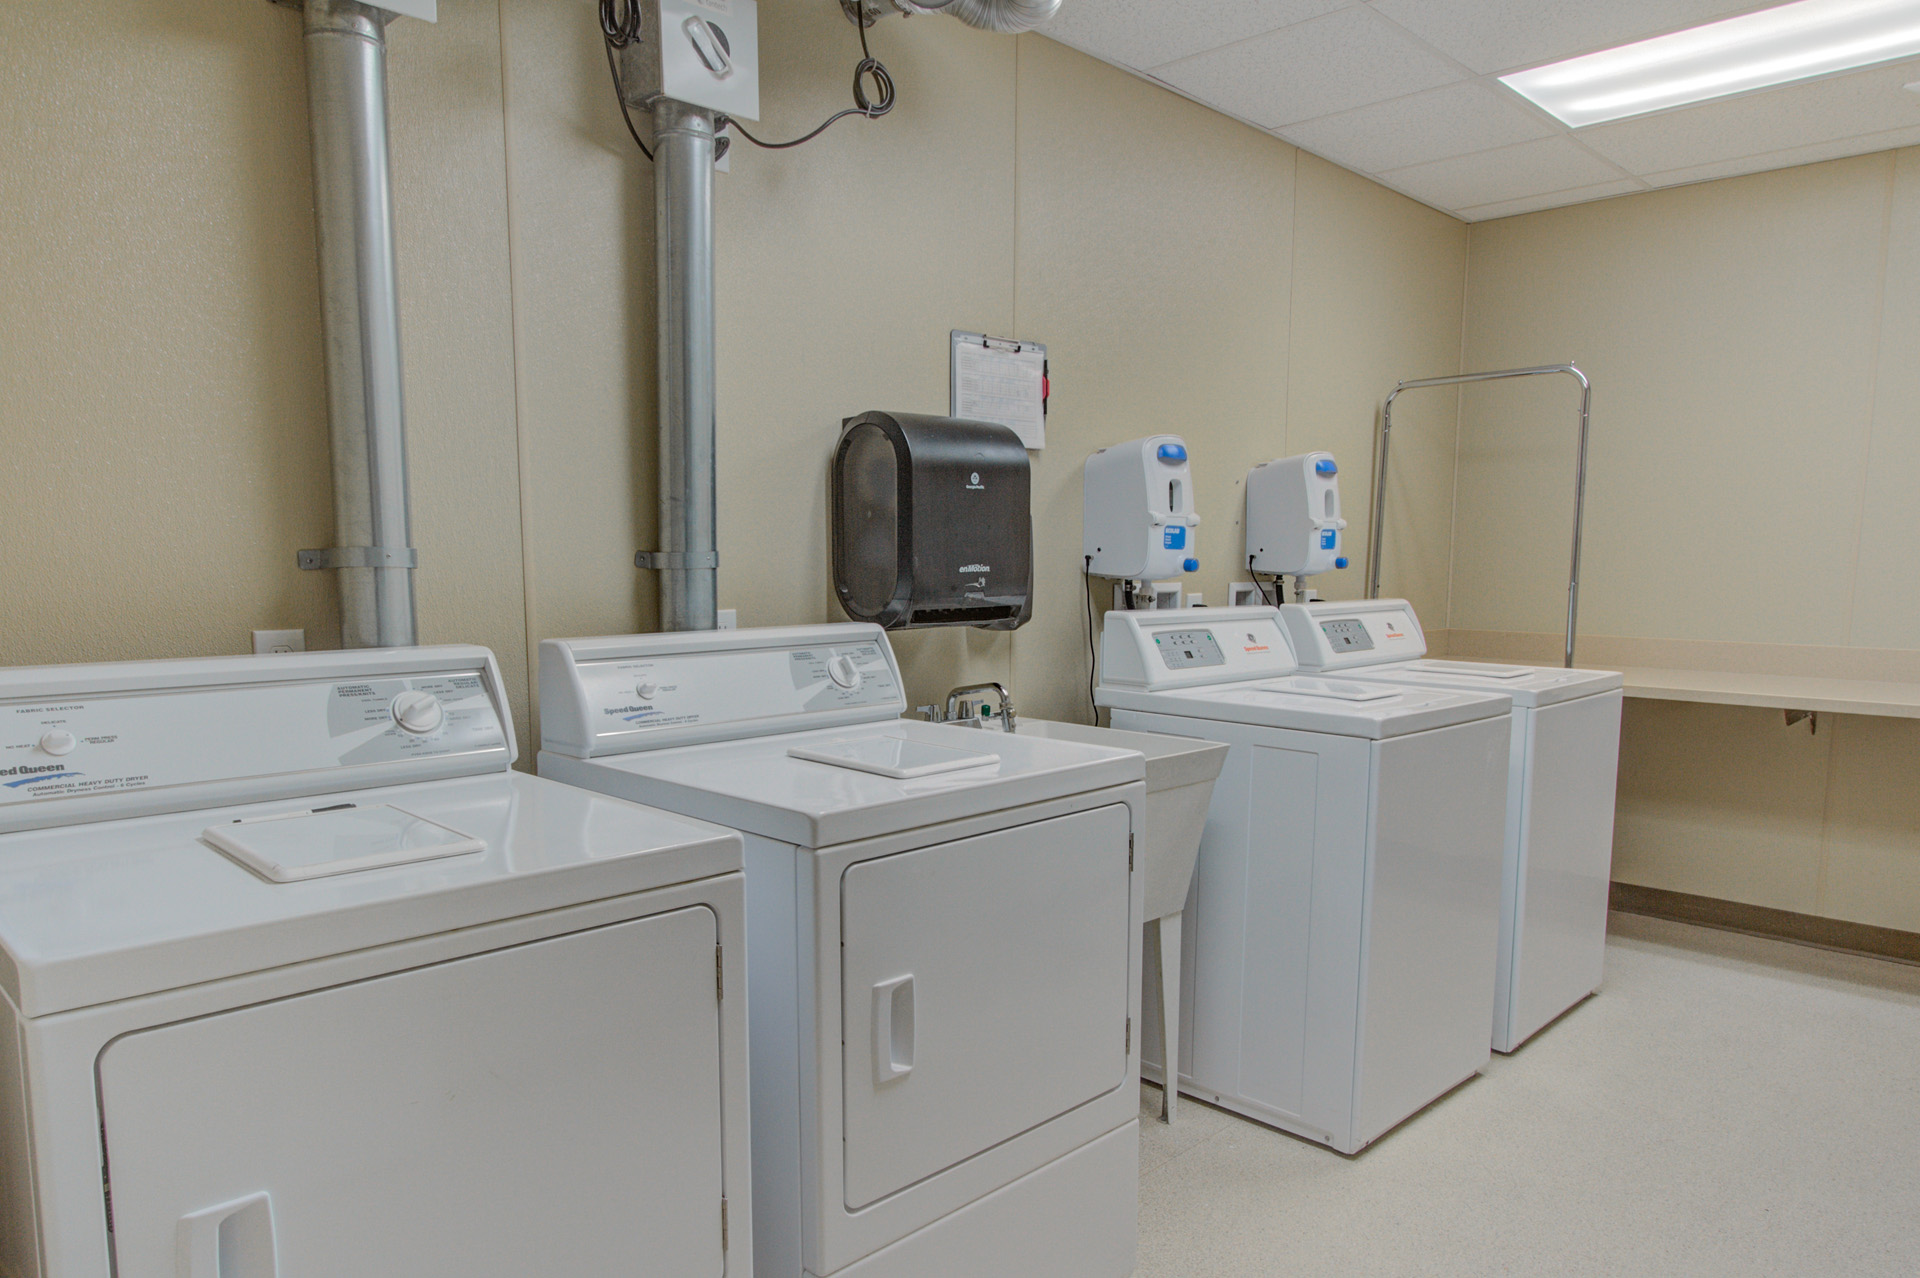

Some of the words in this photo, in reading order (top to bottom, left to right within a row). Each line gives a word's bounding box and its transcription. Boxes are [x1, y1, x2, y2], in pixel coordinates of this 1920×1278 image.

[959, 564, 990, 573] enMotion
[604, 705, 629, 715] Speed
[19, 764, 65, 774] Queen
[27, 783, 75, 792] COMMERCIAL
[32, 788, 64, 797] Automatic
[93, 783, 115, 791] Control
